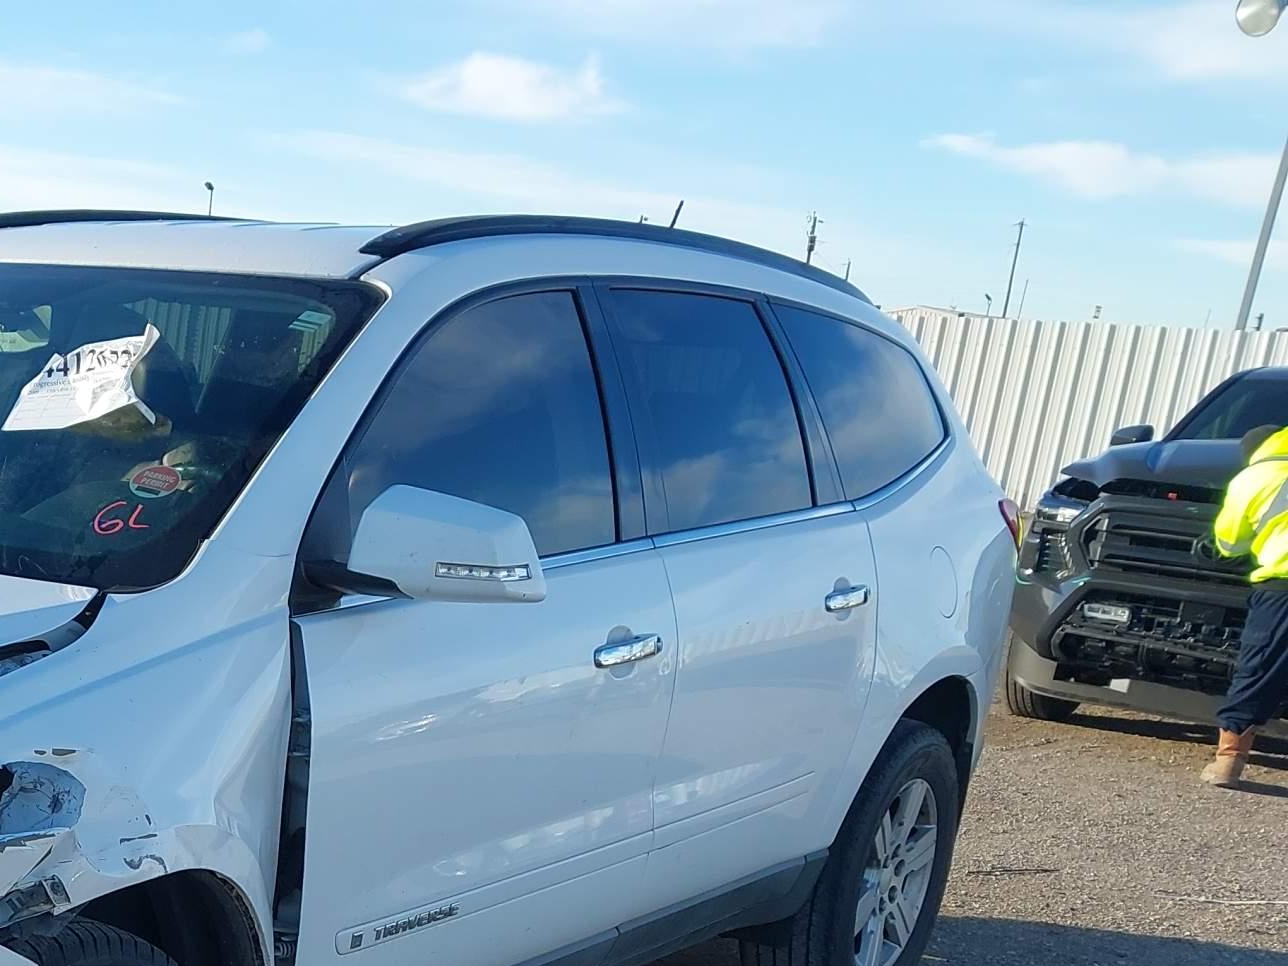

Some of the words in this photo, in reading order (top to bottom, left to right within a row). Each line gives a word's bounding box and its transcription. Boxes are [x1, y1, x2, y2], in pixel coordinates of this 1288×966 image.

[139, 477, 170, 489] PERMIT
[143, 470, 177, 483] PARKING
[373, 901, 461, 941] TRAVERSE
